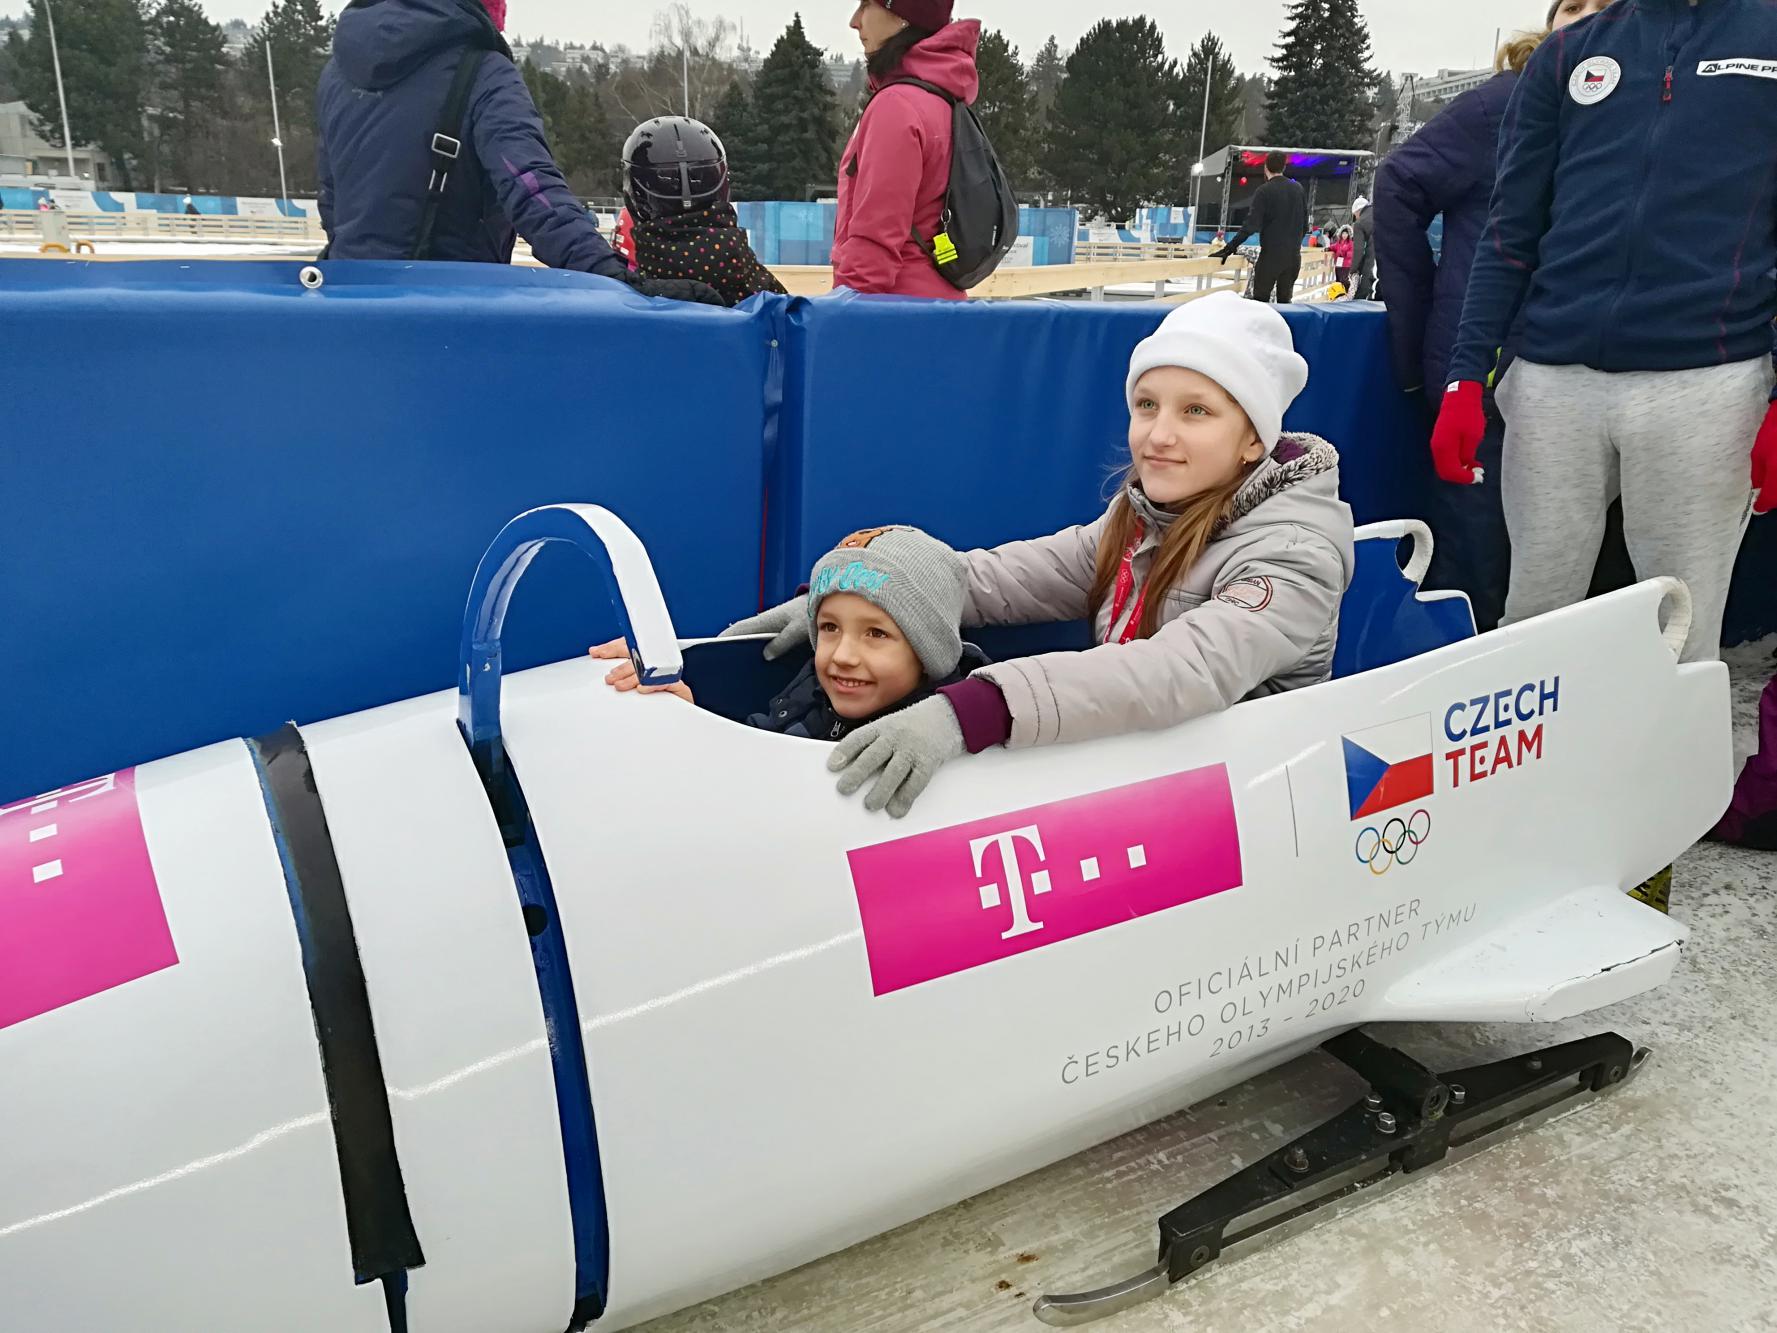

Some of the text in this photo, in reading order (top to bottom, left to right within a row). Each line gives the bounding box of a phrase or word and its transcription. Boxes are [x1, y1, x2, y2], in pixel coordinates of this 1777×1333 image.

[1701, 63, 1760, 73] ALPINE
[1443, 676, 1560, 742] CZECH
[1445, 723, 1544, 788] TEAM
[1154, 899, 1421, 1013] OFICIÁLNÍ PARTNER
[1061, 902, 1477, 1084] ČESKEHO OLYMPIJSKÉHO TÝMU
[1209, 1017, 1271, 1058] 2013
[1305, 979, 1365, 1018] 2020
